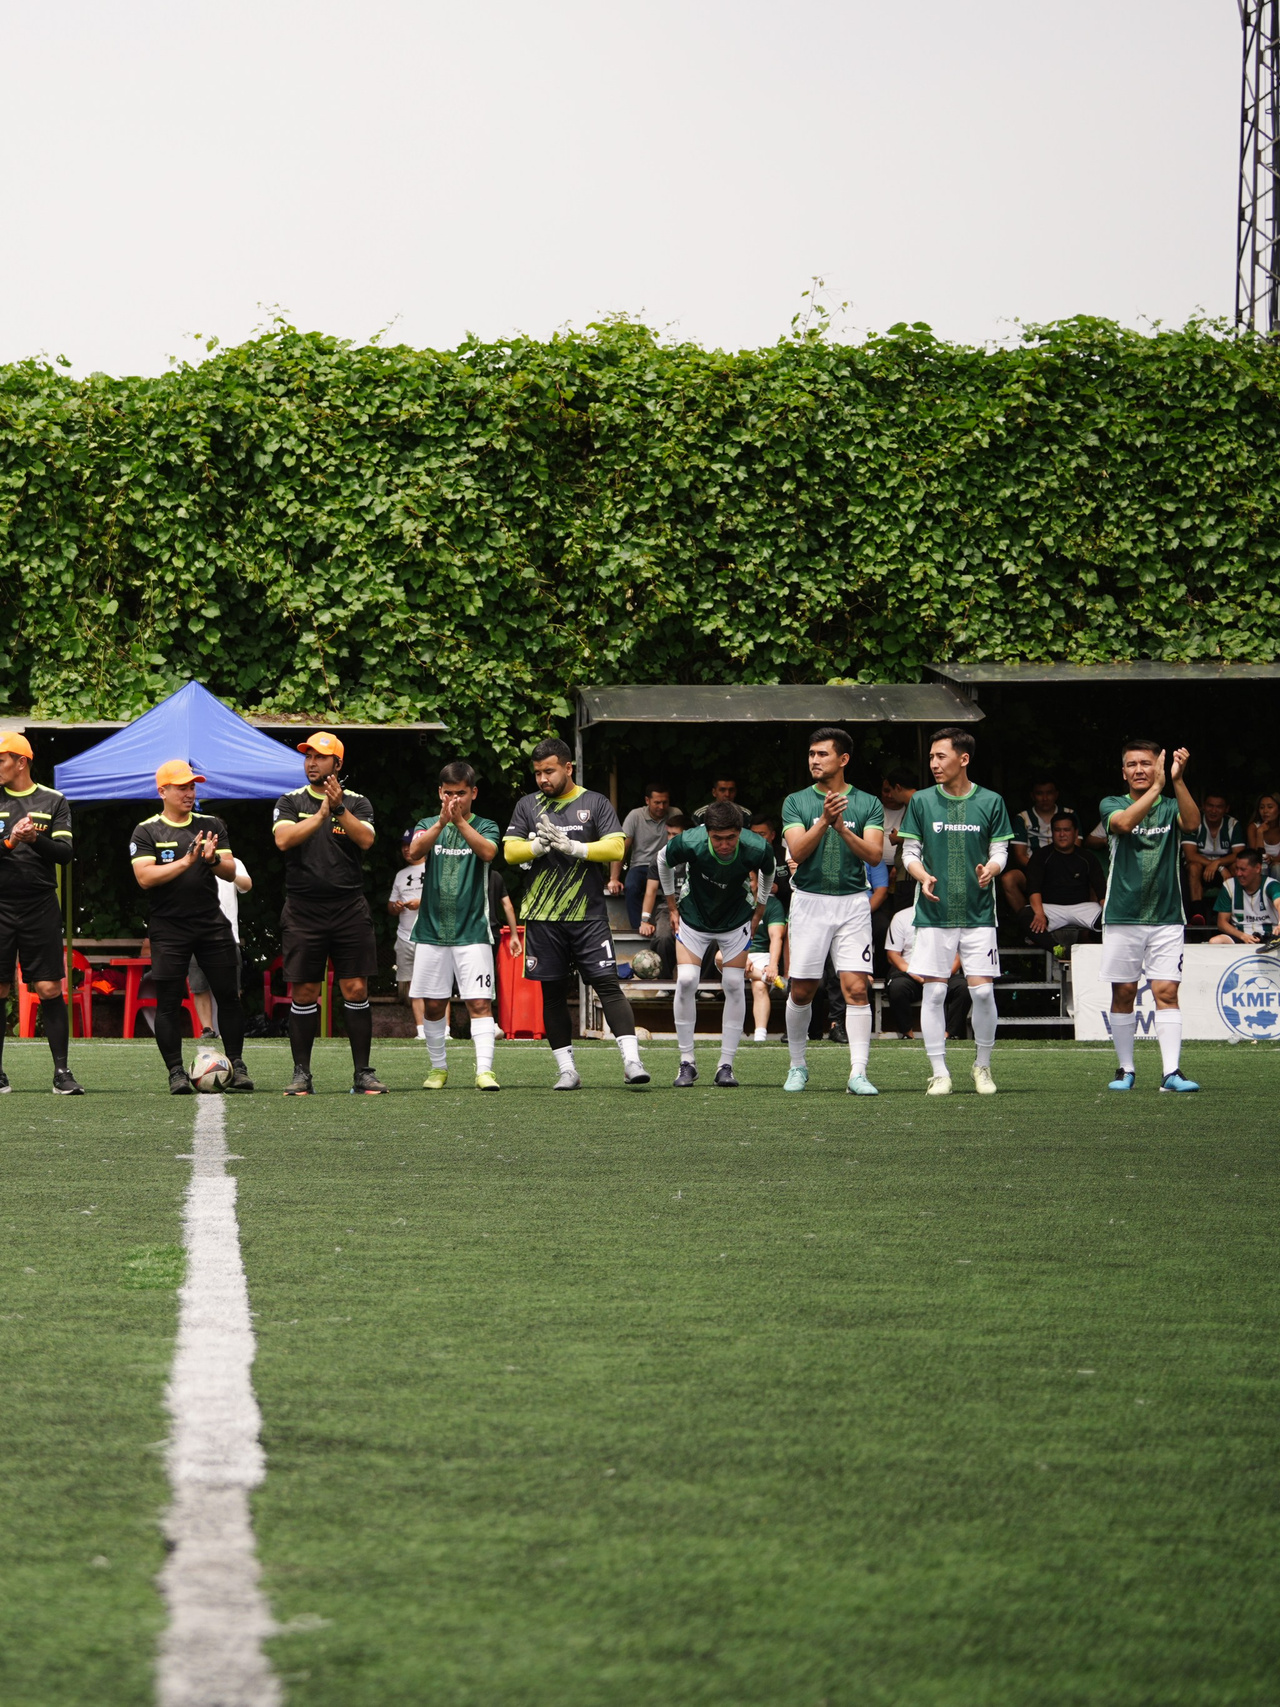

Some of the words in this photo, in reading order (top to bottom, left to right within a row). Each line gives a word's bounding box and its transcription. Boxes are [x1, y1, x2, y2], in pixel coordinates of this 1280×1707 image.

[944, 824, 981, 832] FREEDOM
[1140, 824, 1171, 836] FREEDOM
[600, 940, 613, 959] 1
[862, 944, 871, 962] 6
[475, 974, 491, 988] 18
[1232, 992, 1280, 1007] KMF
